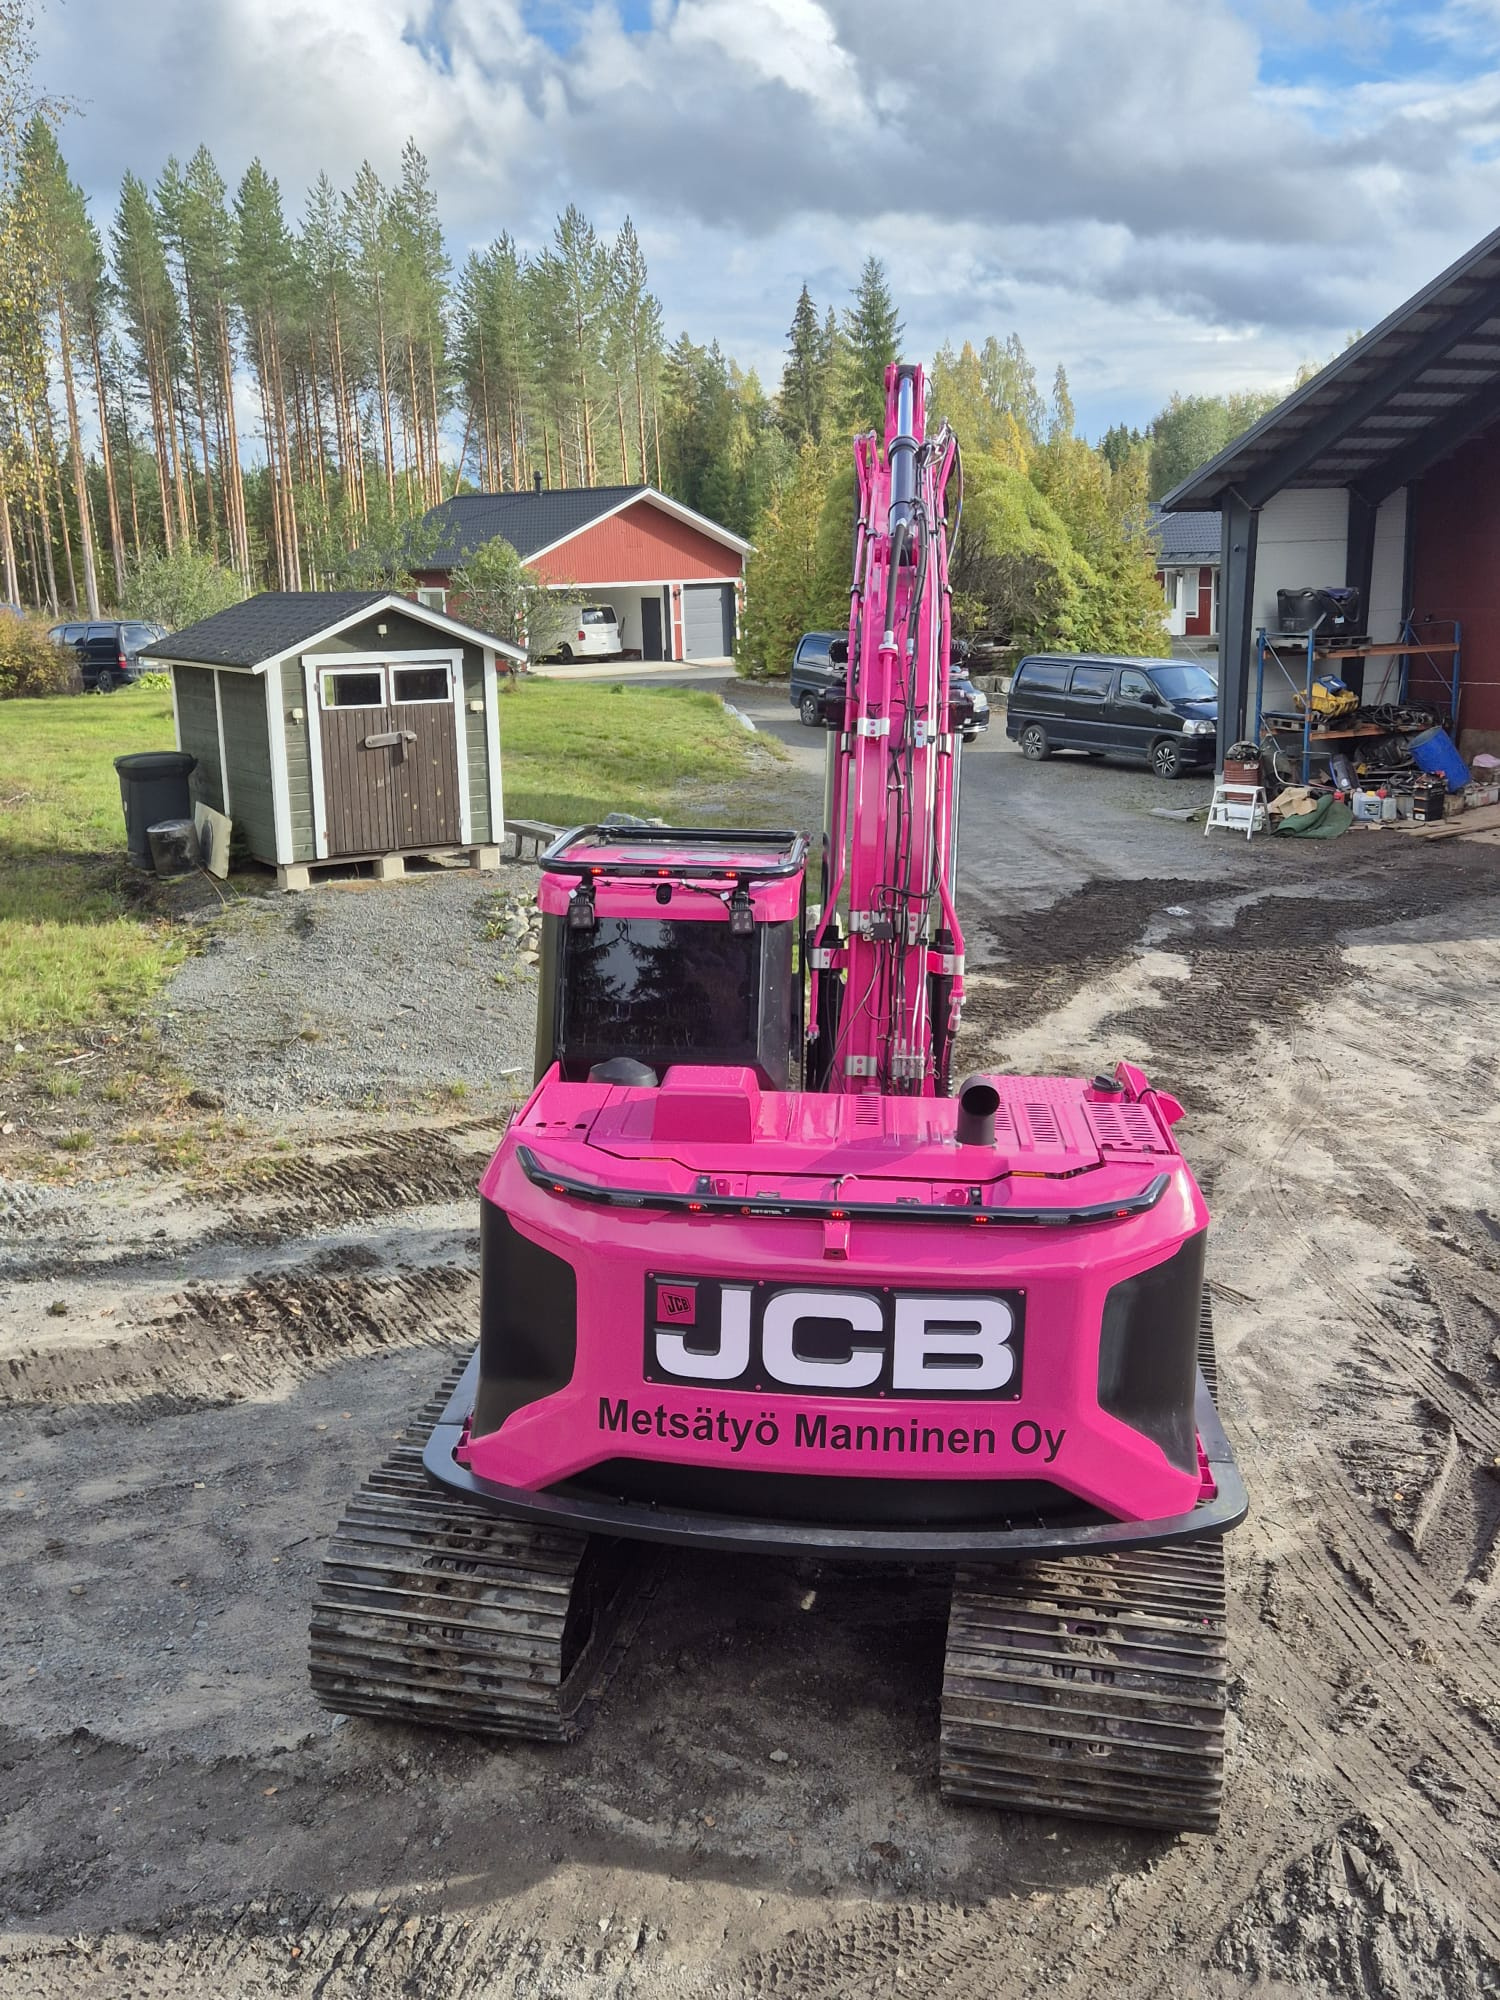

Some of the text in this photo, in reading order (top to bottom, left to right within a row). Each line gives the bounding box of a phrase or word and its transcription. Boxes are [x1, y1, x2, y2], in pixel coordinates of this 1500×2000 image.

[667, 1295, 689, 1313] JCB
[655, 1289, 1014, 1390] JCB
[599, 1397, 1067, 1463] Metsätyö Manninen Oy
